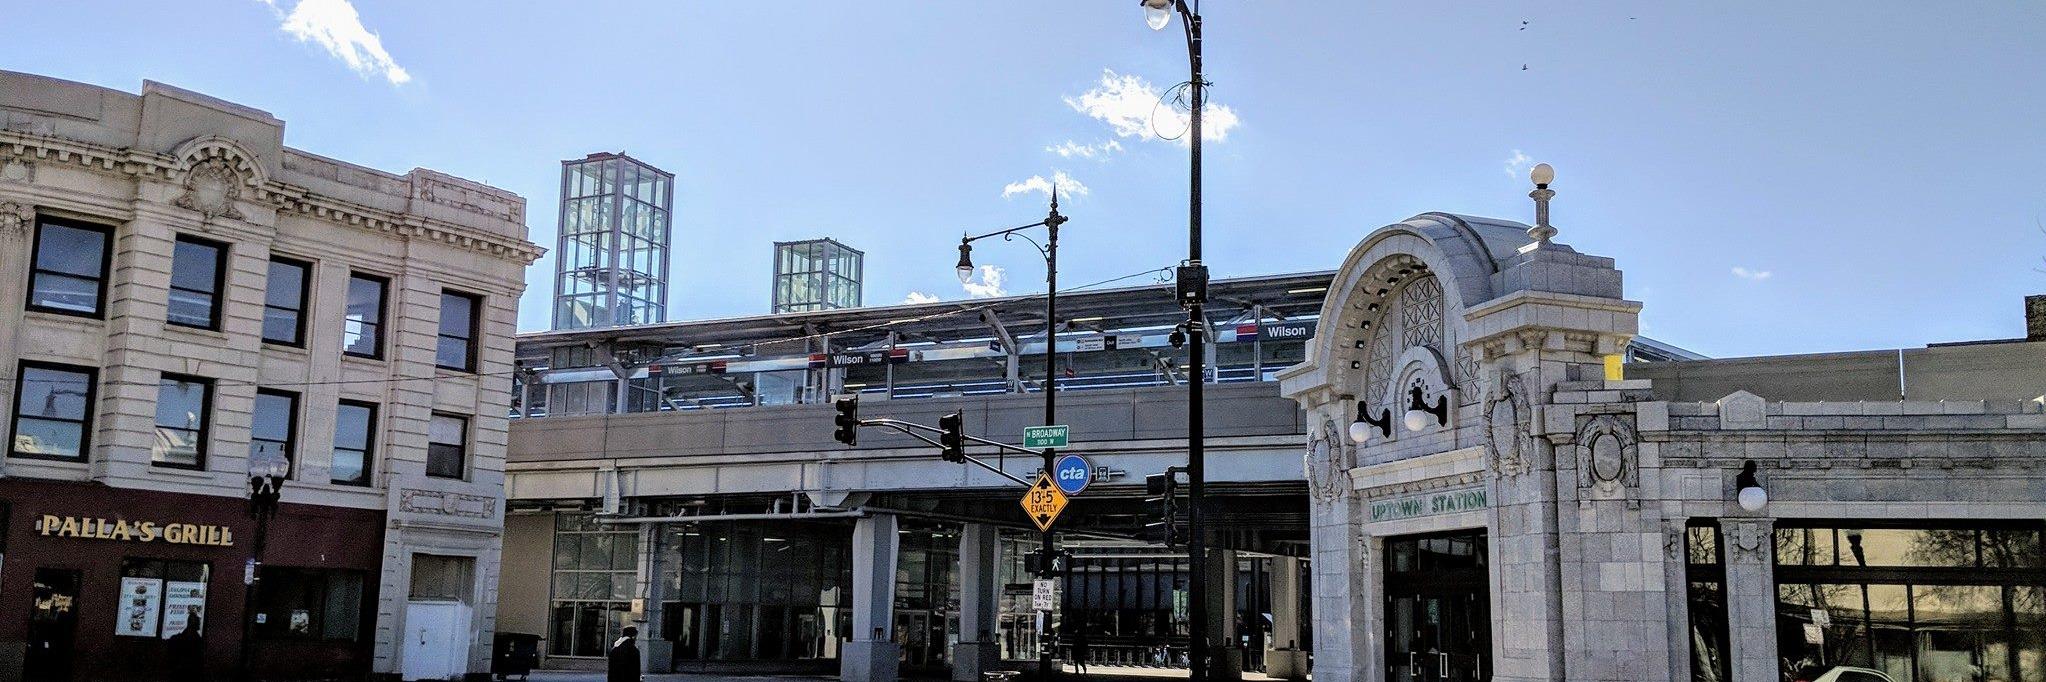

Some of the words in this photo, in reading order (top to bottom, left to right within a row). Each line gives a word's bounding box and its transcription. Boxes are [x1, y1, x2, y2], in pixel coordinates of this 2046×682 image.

[1268, 326, 1306, 338] Wilson
[833, 355, 863, 365] Wilson
[668, 366, 692, 374] Wilson
[1032, 428, 1065, 438] BROADWAY
[1060, 467, 1085, 480] cta
[1031, 504, 1057, 513] EXACTLY
[1372, 498, 1422, 520] UPTOWN
[1432, 490, 1487, 513] STATION
[41, 514, 155, 542] PALLA'S
[164, 522, 234, 546] GRILL
